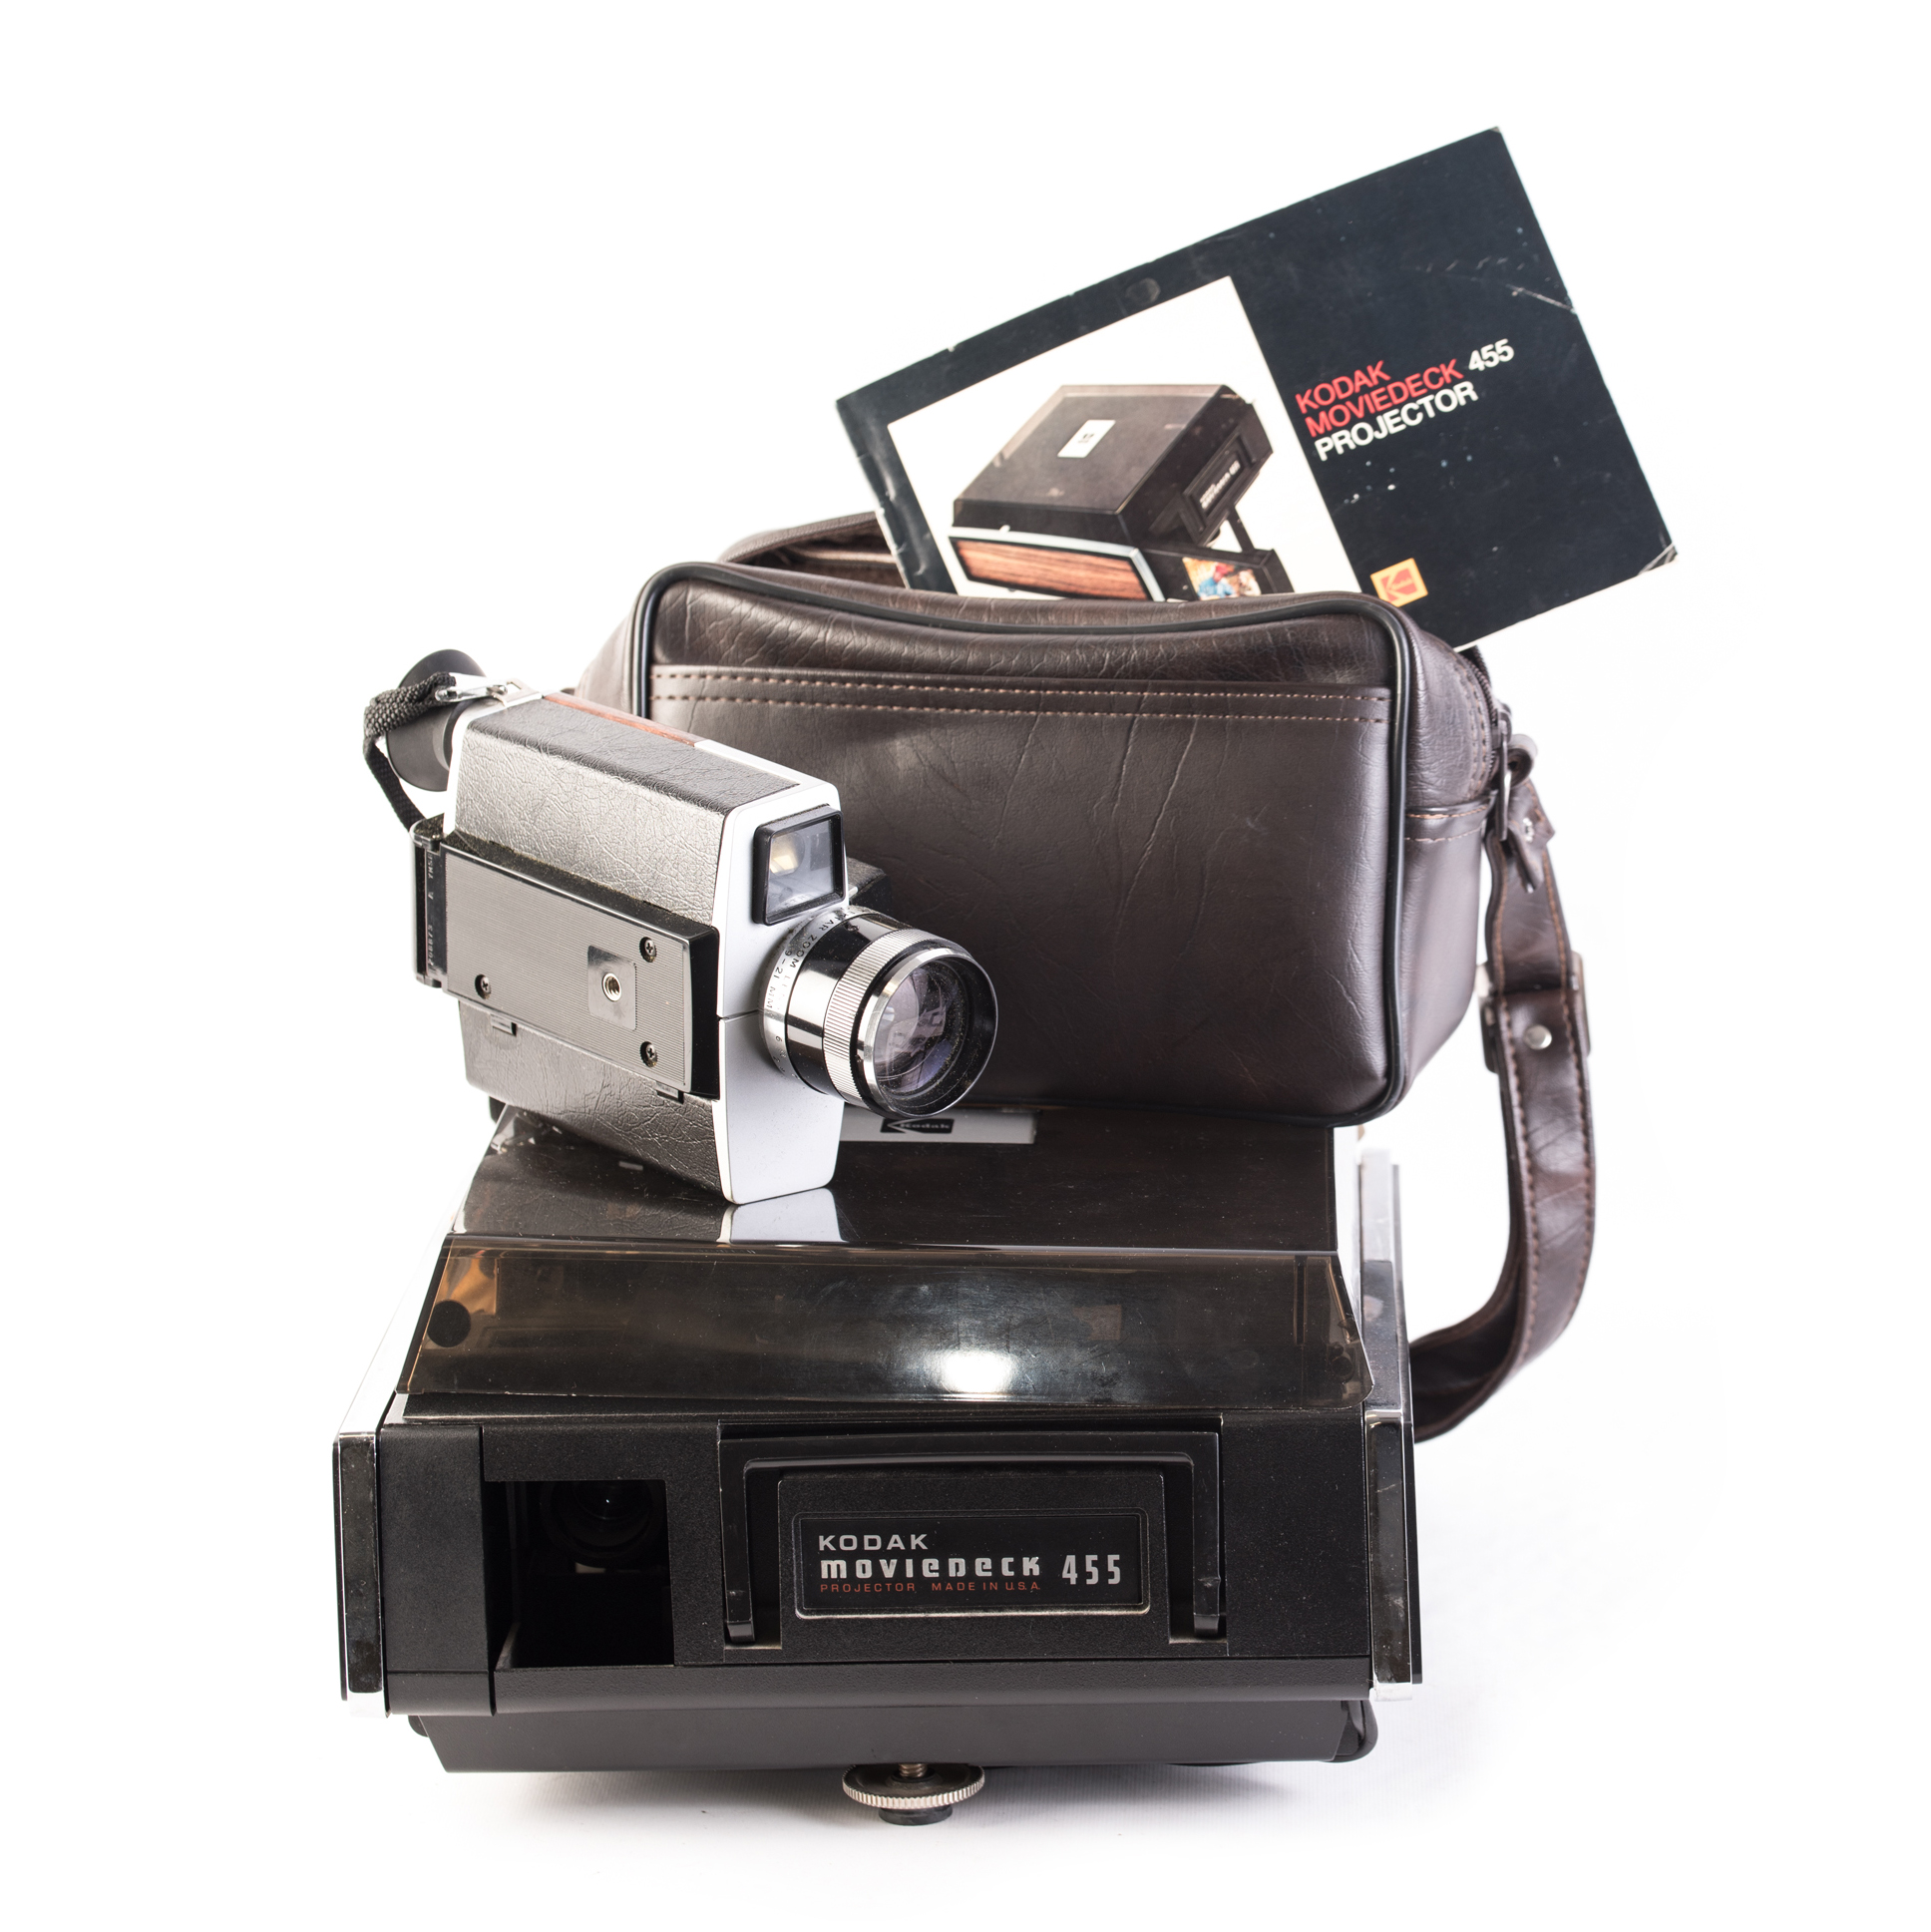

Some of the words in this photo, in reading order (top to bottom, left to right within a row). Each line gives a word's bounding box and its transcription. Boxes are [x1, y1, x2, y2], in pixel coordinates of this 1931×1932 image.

[1296, 360, 1390, 414] KODAK
[1305, 359, 1464, 437] MOVIEDECK
[1468, 338, 1514, 371] 455
[1315, 381, 1479, 461] PROJECTOR
[773, 950, 792, 978] 9-21
[789, 934, 818, 968] ZOOM
[818, 1533, 929, 1551] KODAK
[1061, 1554, 1121, 1585] 455
[820, 1583, 916, 1593] PROJECTOR
[932, 1582, 976, 1592] MADE
[982, 1582, 998, 1591] IN
